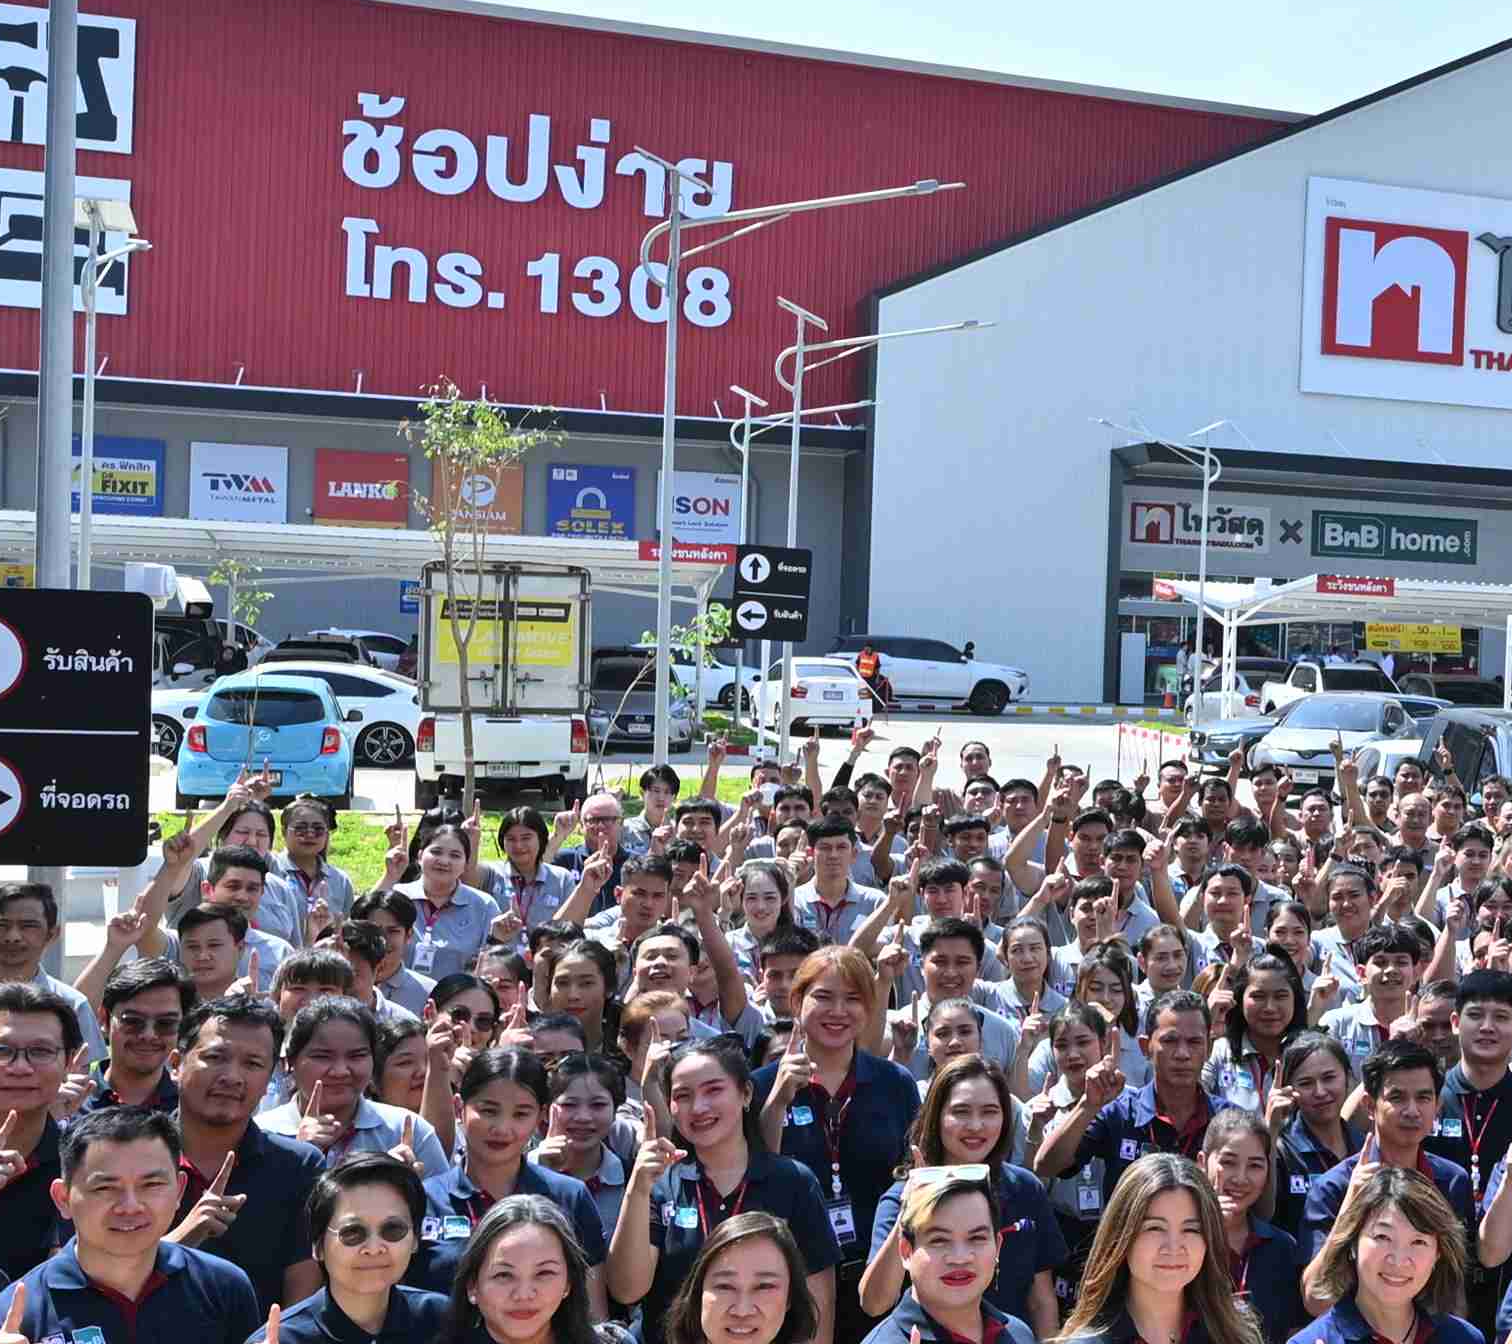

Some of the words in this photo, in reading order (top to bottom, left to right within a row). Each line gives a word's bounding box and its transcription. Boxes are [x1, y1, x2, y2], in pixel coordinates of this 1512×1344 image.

[341, 92, 733, 220] ช้อปง่าย
[341, 217, 505, 310] โทร.
[525, 252, 732, 328] 1308
[101, 480, 149, 495] FIXIT
[1324, 522, 1381, 549] BnB
[1391, 527, 1461, 553] home
[42, 647, 133, 673] รับสินค้า
[39, 779, 130, 810] ที่จอดรถ
